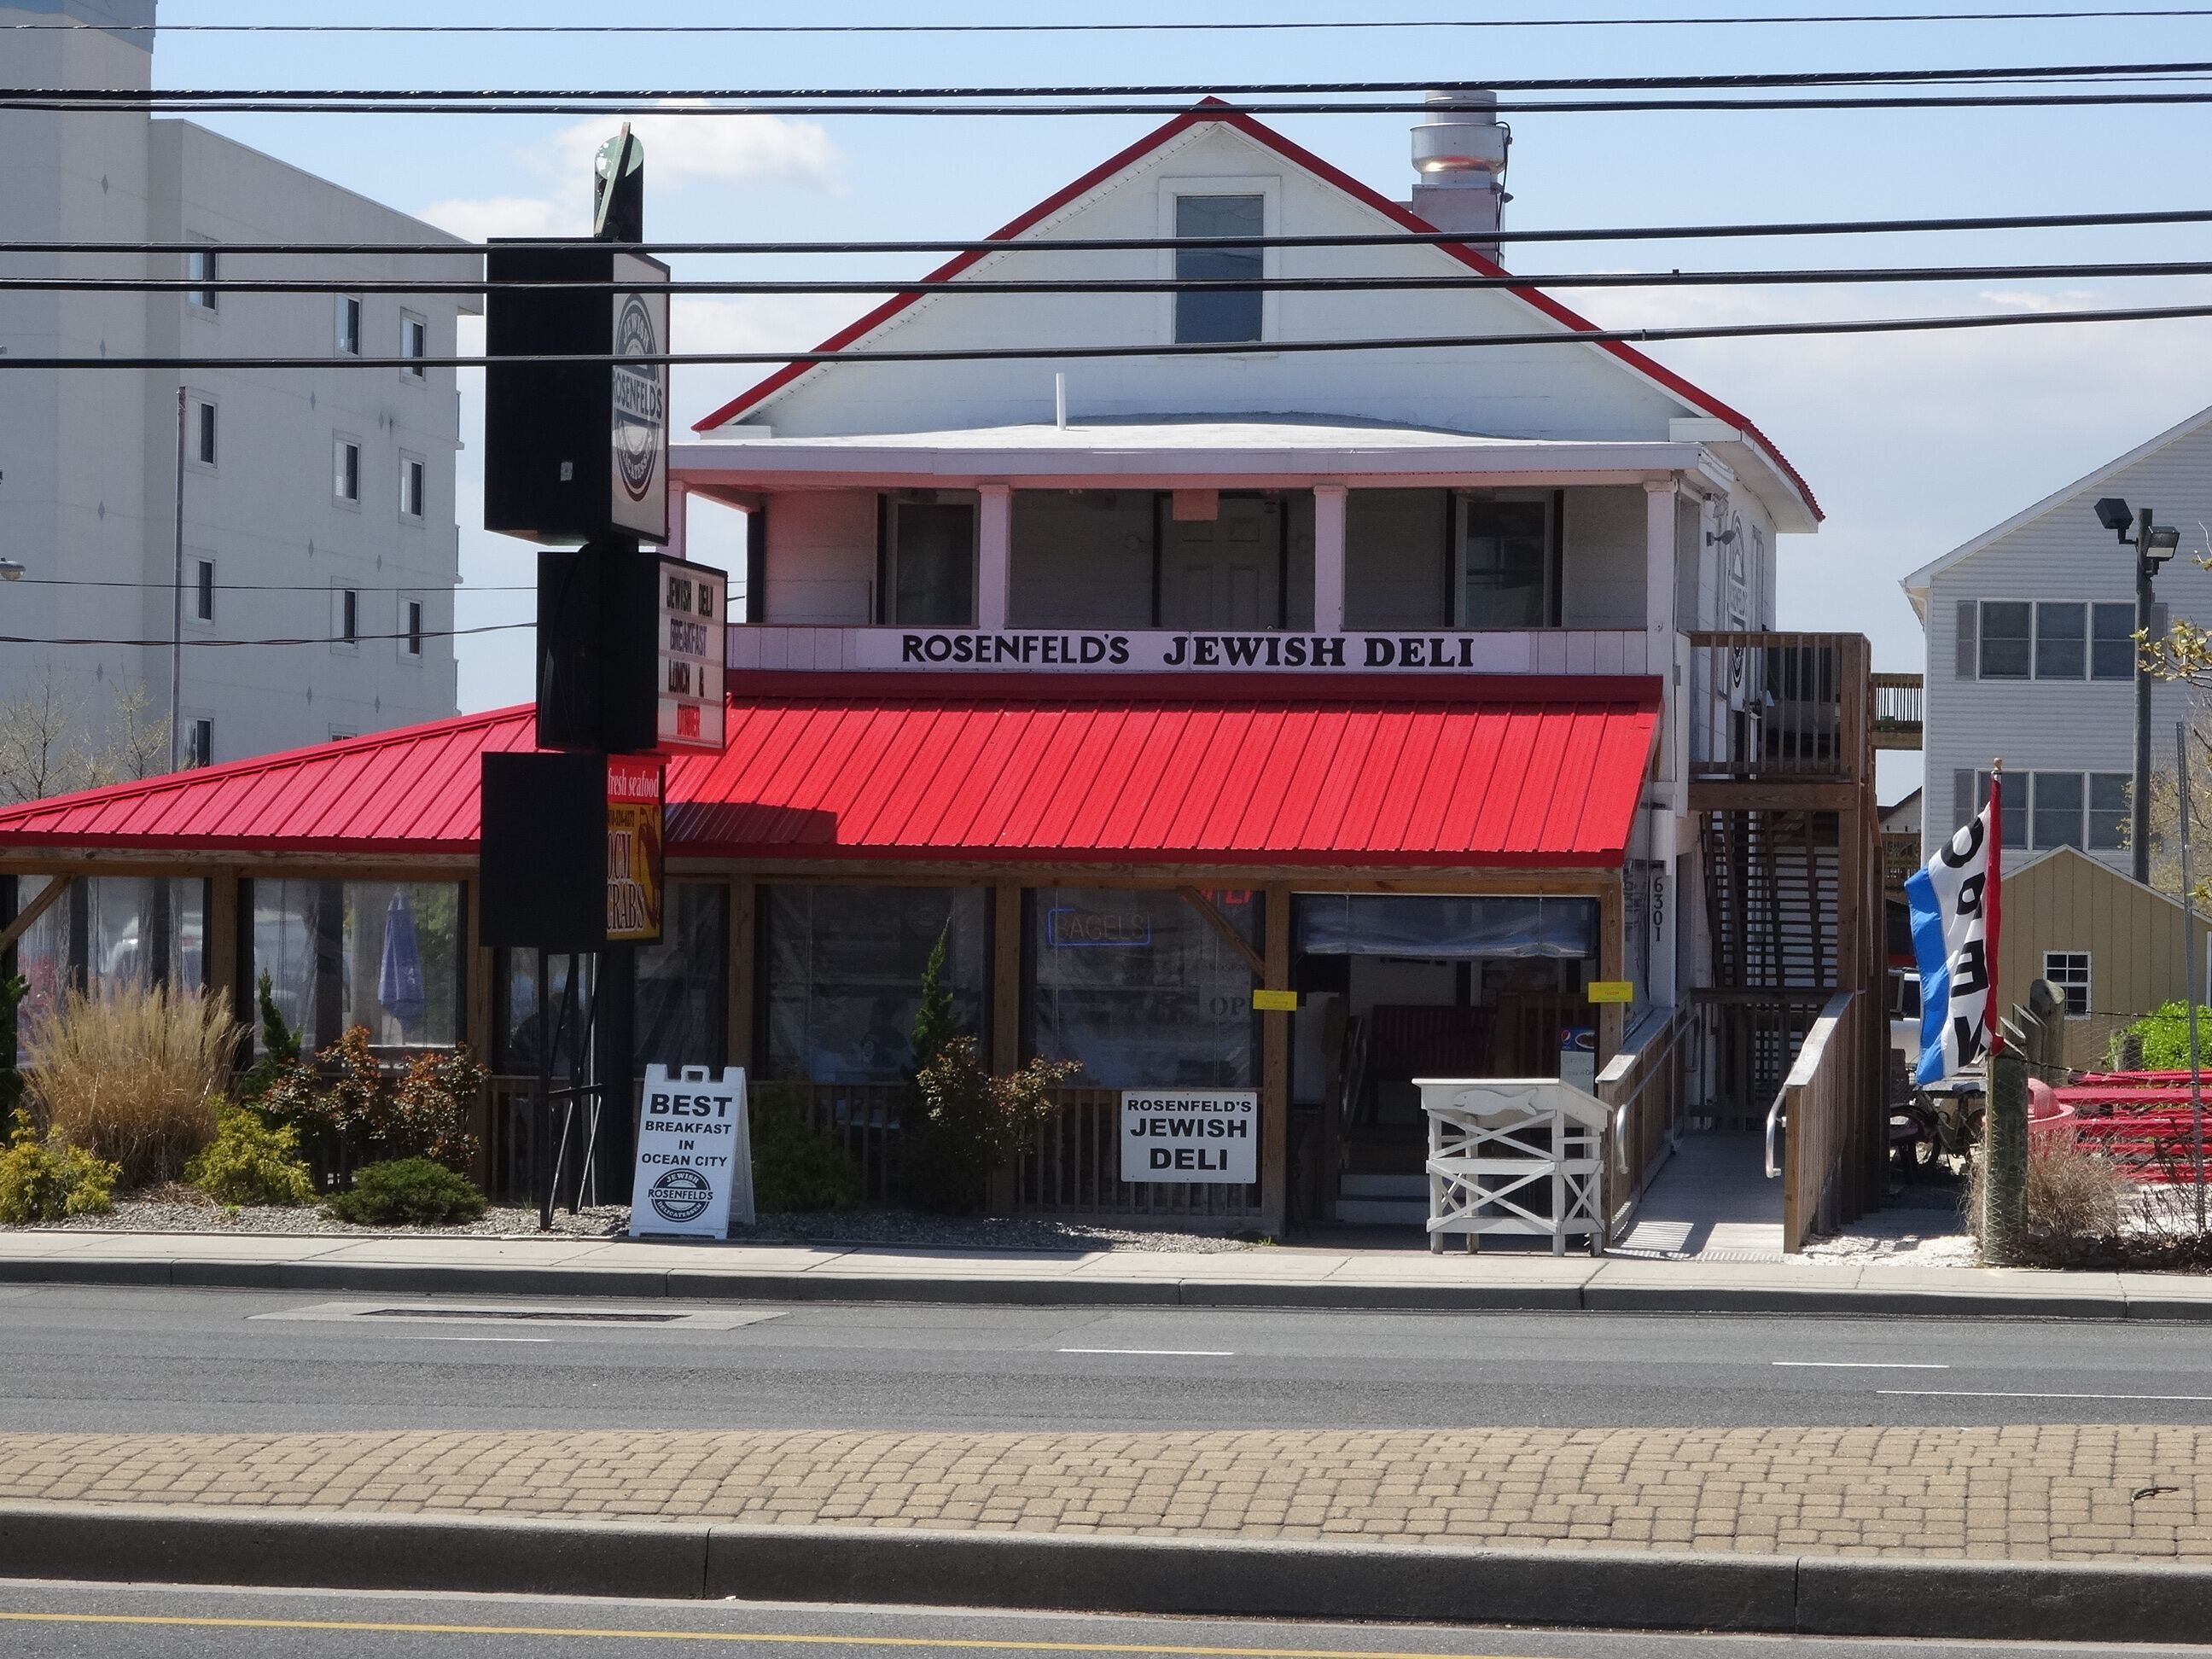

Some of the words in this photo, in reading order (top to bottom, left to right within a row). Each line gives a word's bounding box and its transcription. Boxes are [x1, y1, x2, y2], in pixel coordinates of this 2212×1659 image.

[624, 313, 649, 352] JEWISH
[667, 577, 691, 612] JEWISH
[698, 583, 713, 618] DELI
[670, 618, 707, 657] BREAKFAST
[902, 633, 1130, 664] ROSENFELD'S
[1163, 637, 1346, 667] JEWISH
[1364, 637, 1475, 667] DELI
[668, 657, 690, 695] LUNCH
[699, 666, 704, 697] &
[608, 767, 627, 795] fresh
[628, 770, 660, 798] seafood
[649, 1093, 733, 1117] BEST
[1127, 1099, 1252, 1113] ROSENFELD'S
[645, 1121, 731, 1135] BREAKFAST
[1130, 1118, 1247, 1138] JEWISH
[678, 1139, 695, 1150] IN
[641, 1153, 690, 1166] OCEAN
[695, 1155, 728, 1167] CITY
[1150, 1148, 1228, 1171] DELI
[667, 1173, 699, 1184] JEWISH
[657, 1201, 701, 1218] DELICATESSEN
